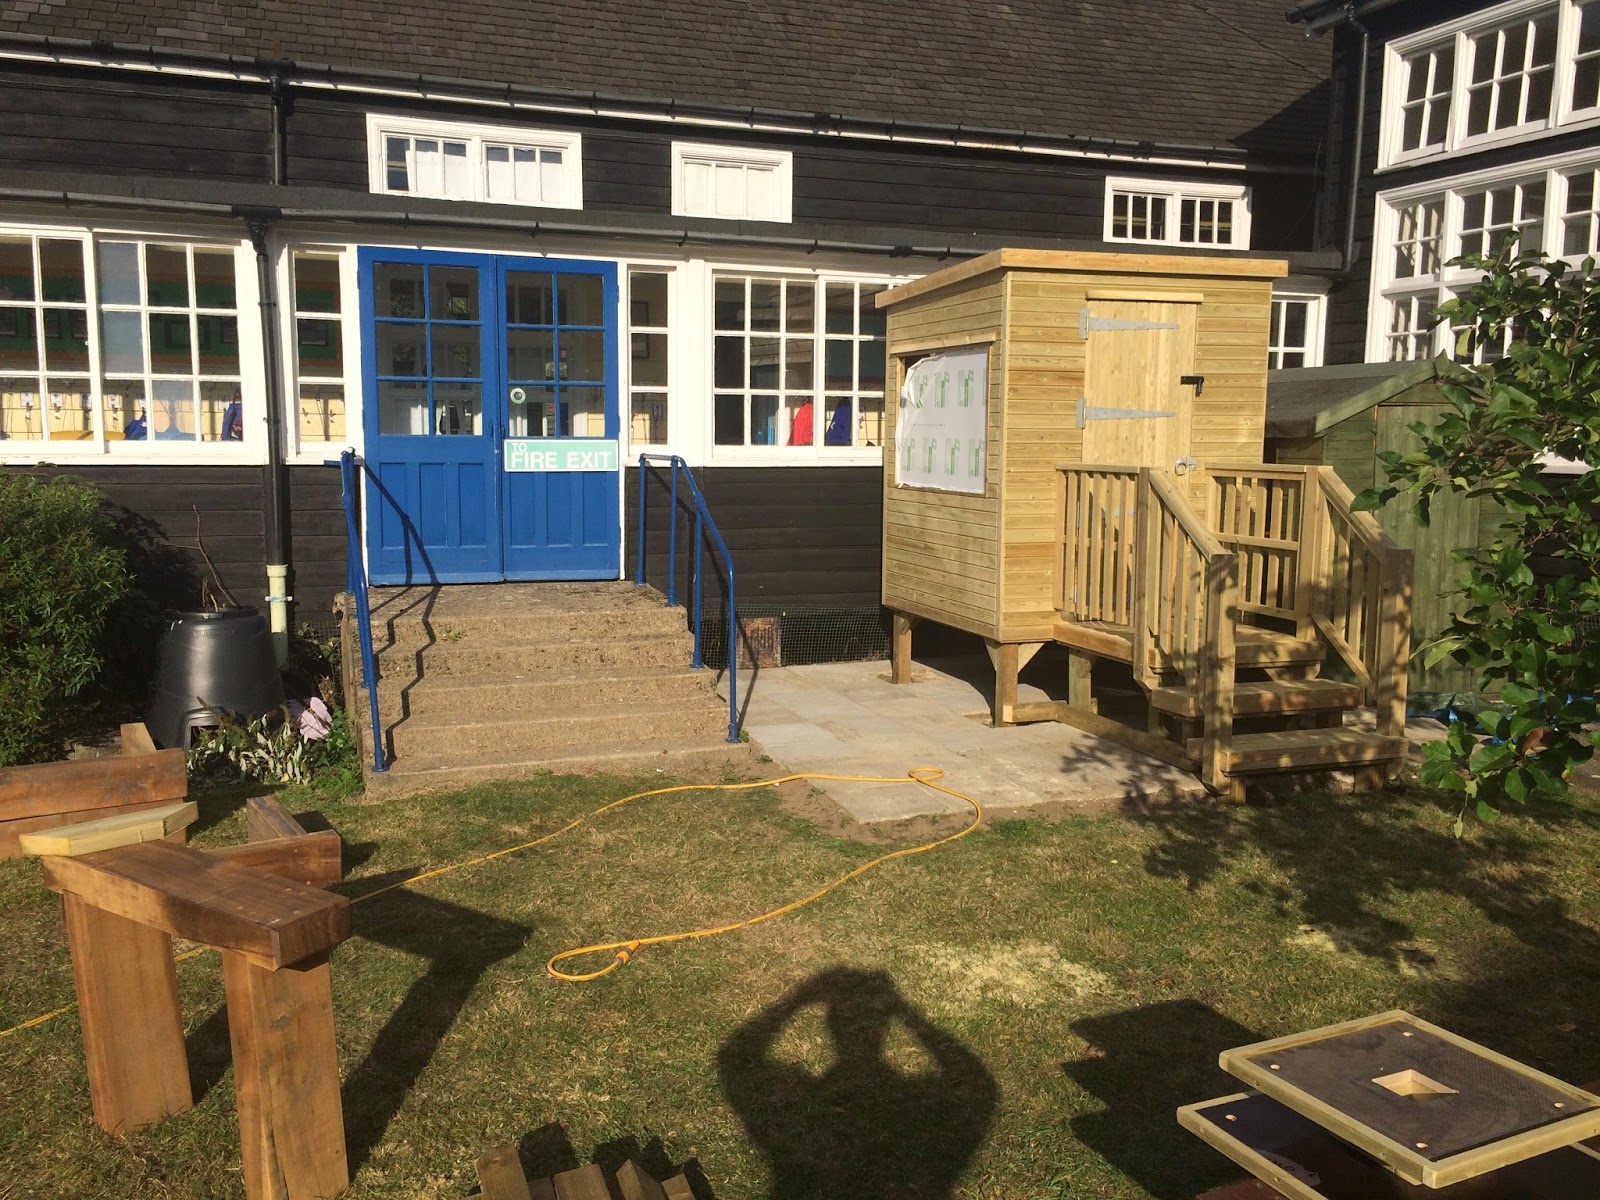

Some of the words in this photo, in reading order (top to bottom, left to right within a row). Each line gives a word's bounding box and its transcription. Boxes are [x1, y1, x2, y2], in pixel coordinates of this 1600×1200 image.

[511, 442, 527, 452] TO
[511, 452, 557, 468] FIRE
[566, 452, 612, 468] EXIT
